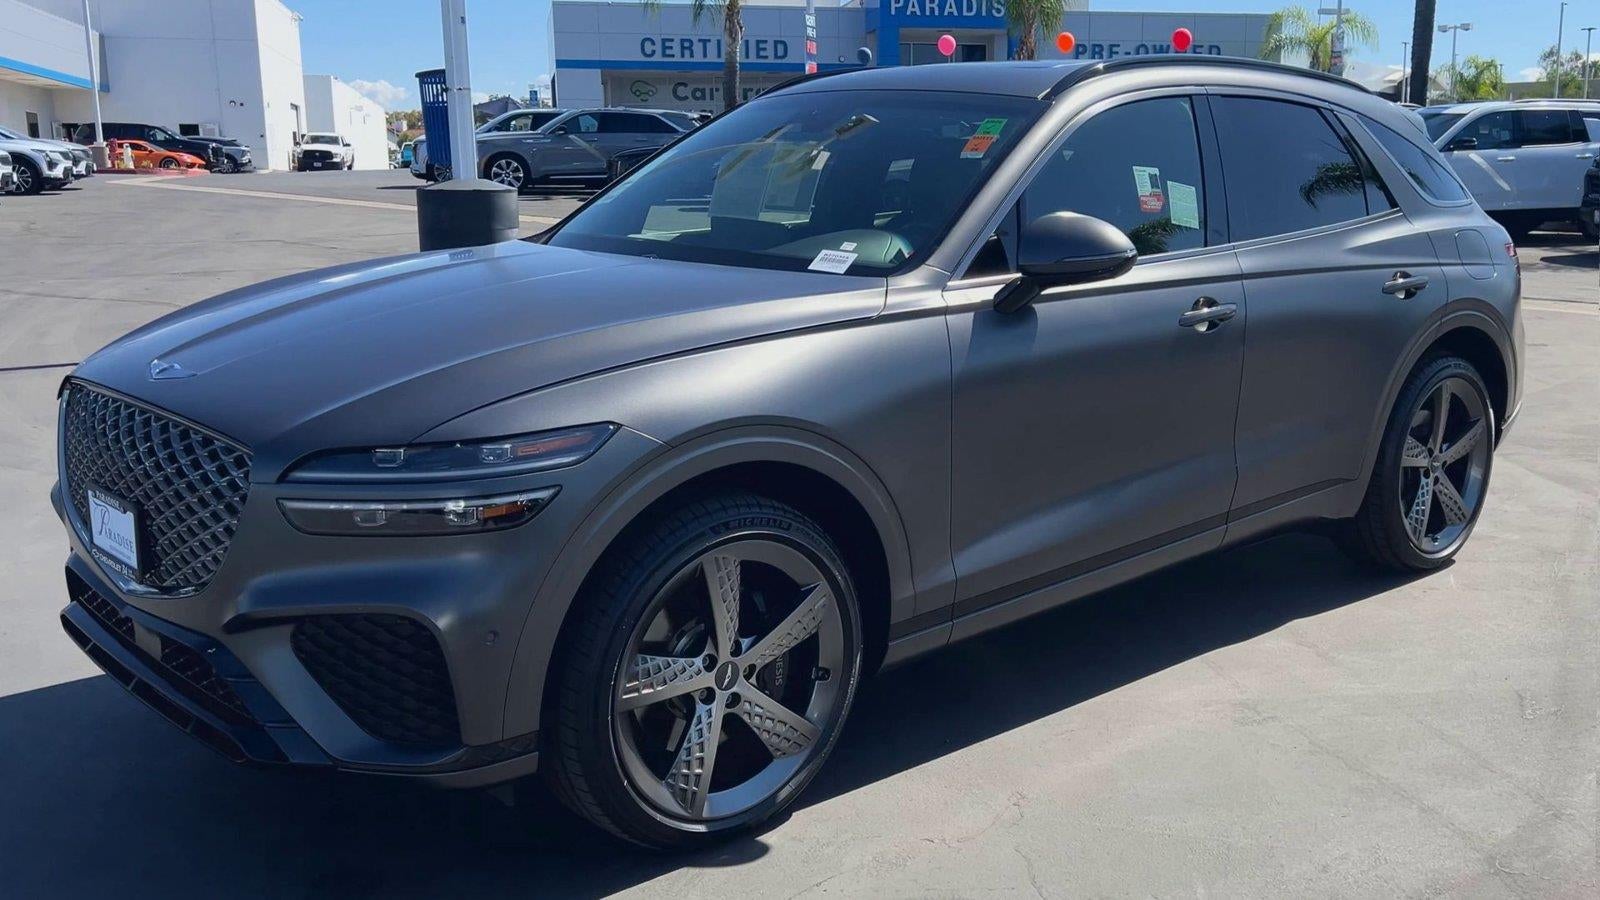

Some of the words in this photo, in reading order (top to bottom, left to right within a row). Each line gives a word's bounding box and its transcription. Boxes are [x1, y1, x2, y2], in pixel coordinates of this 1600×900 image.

[890, 0, 1005, 17] PARADIS
[640, 37, 789, 60] CERTIIED
[1073, 43, 1221, 60] PRE-OWED
[775, 655, 784, 686] NESIS
